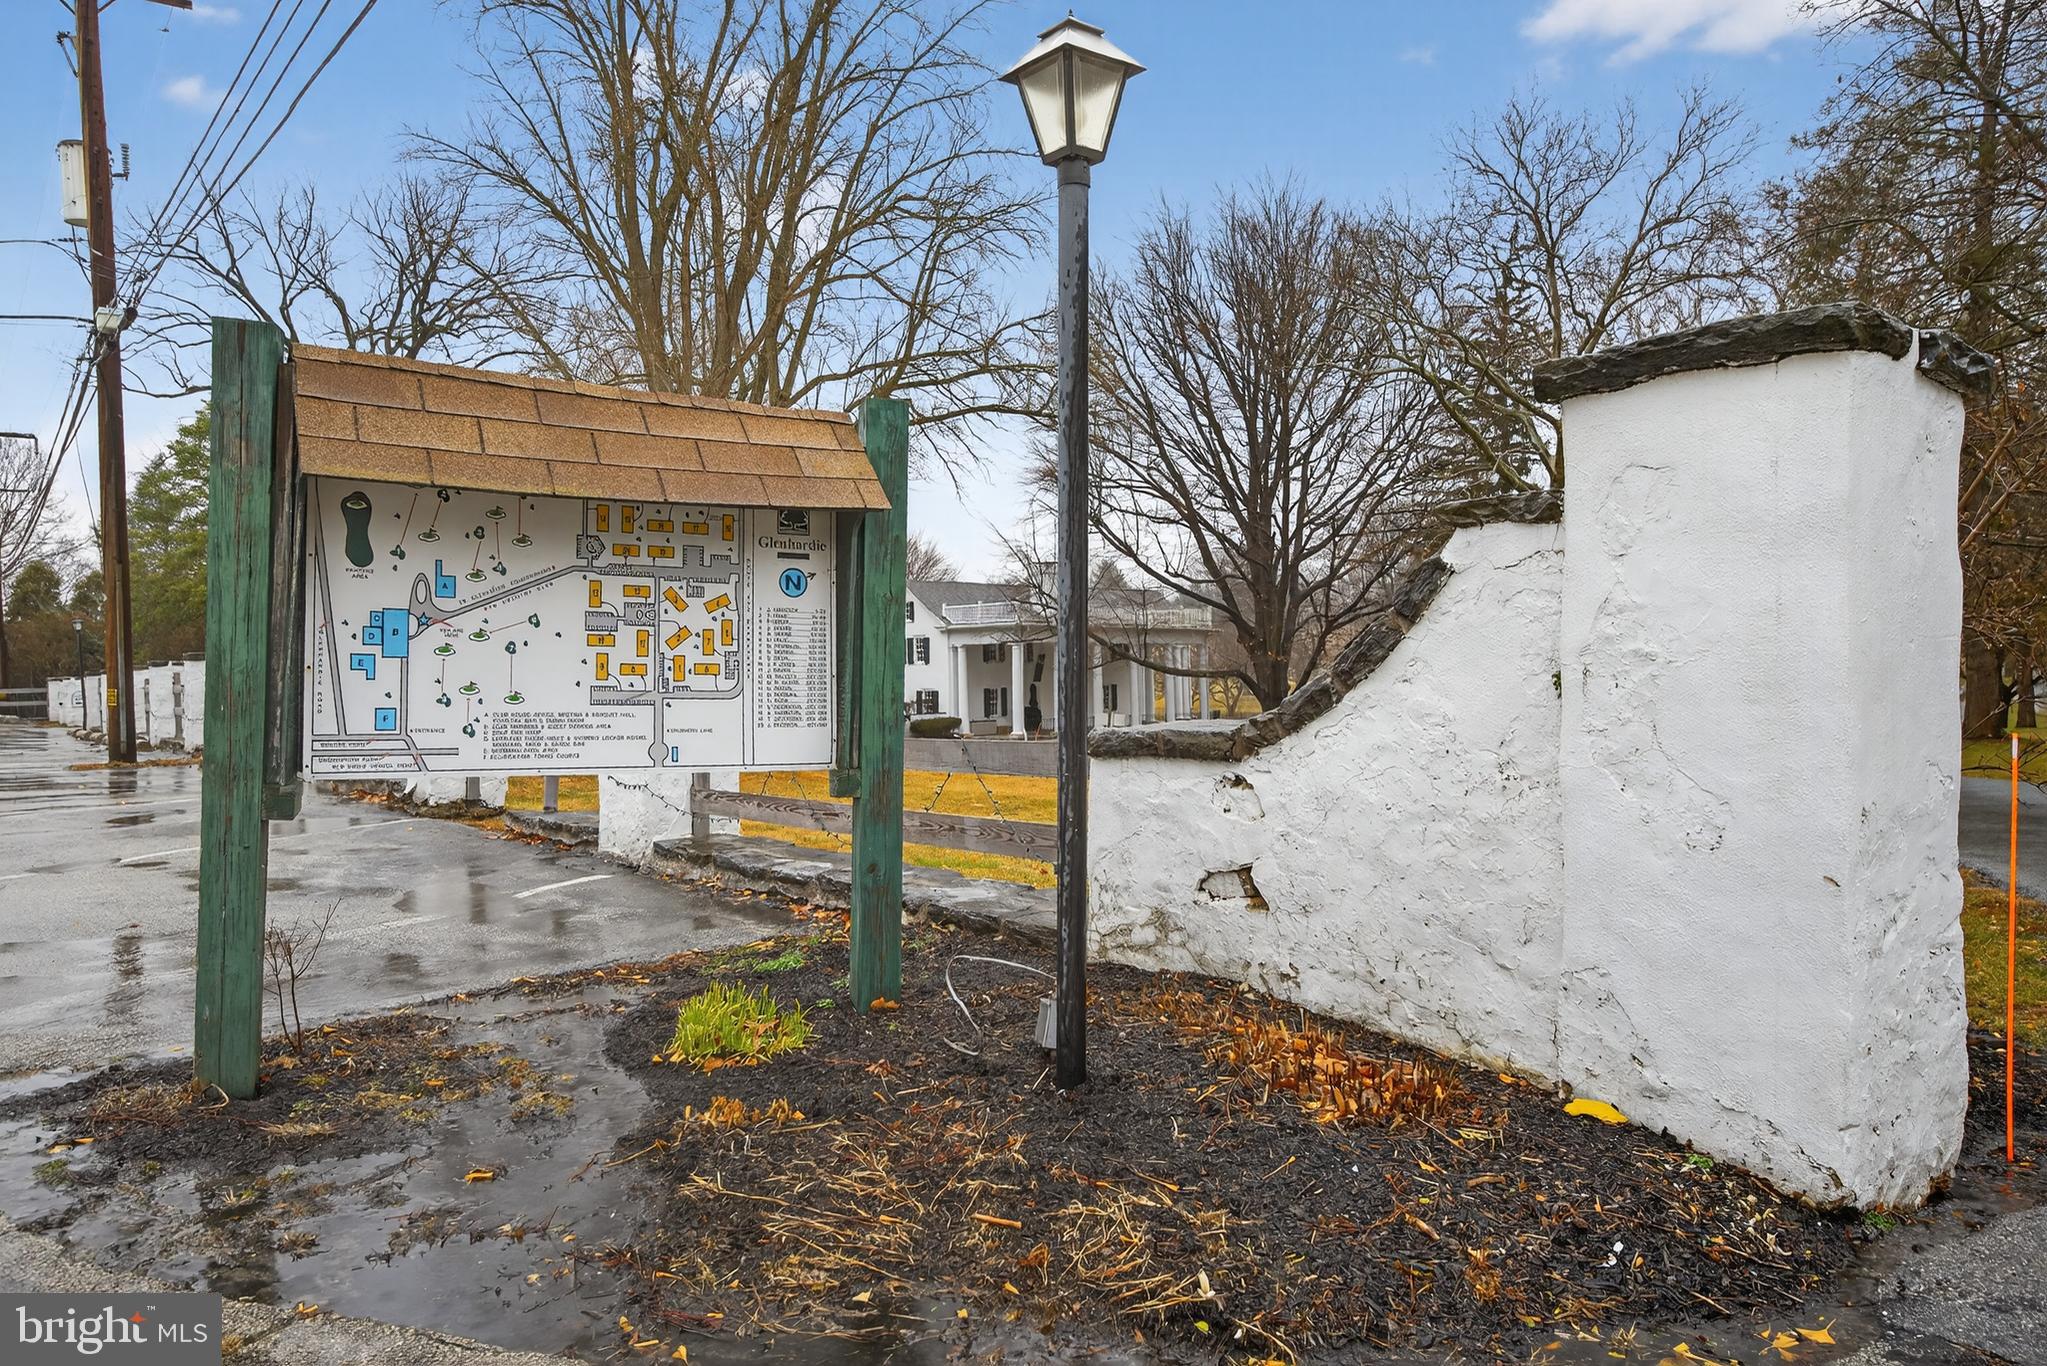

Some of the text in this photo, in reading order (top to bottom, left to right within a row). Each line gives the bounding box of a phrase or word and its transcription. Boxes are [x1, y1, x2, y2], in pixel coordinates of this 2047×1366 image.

[758, 536, 827, 552] Glenhardie
[442, 582, 448, 590] A
[785, 574, 802, 591] N
[392, 628, 398, 636] B
[358, 658, 364, 667] E
[383, 714, 388, 722] F
